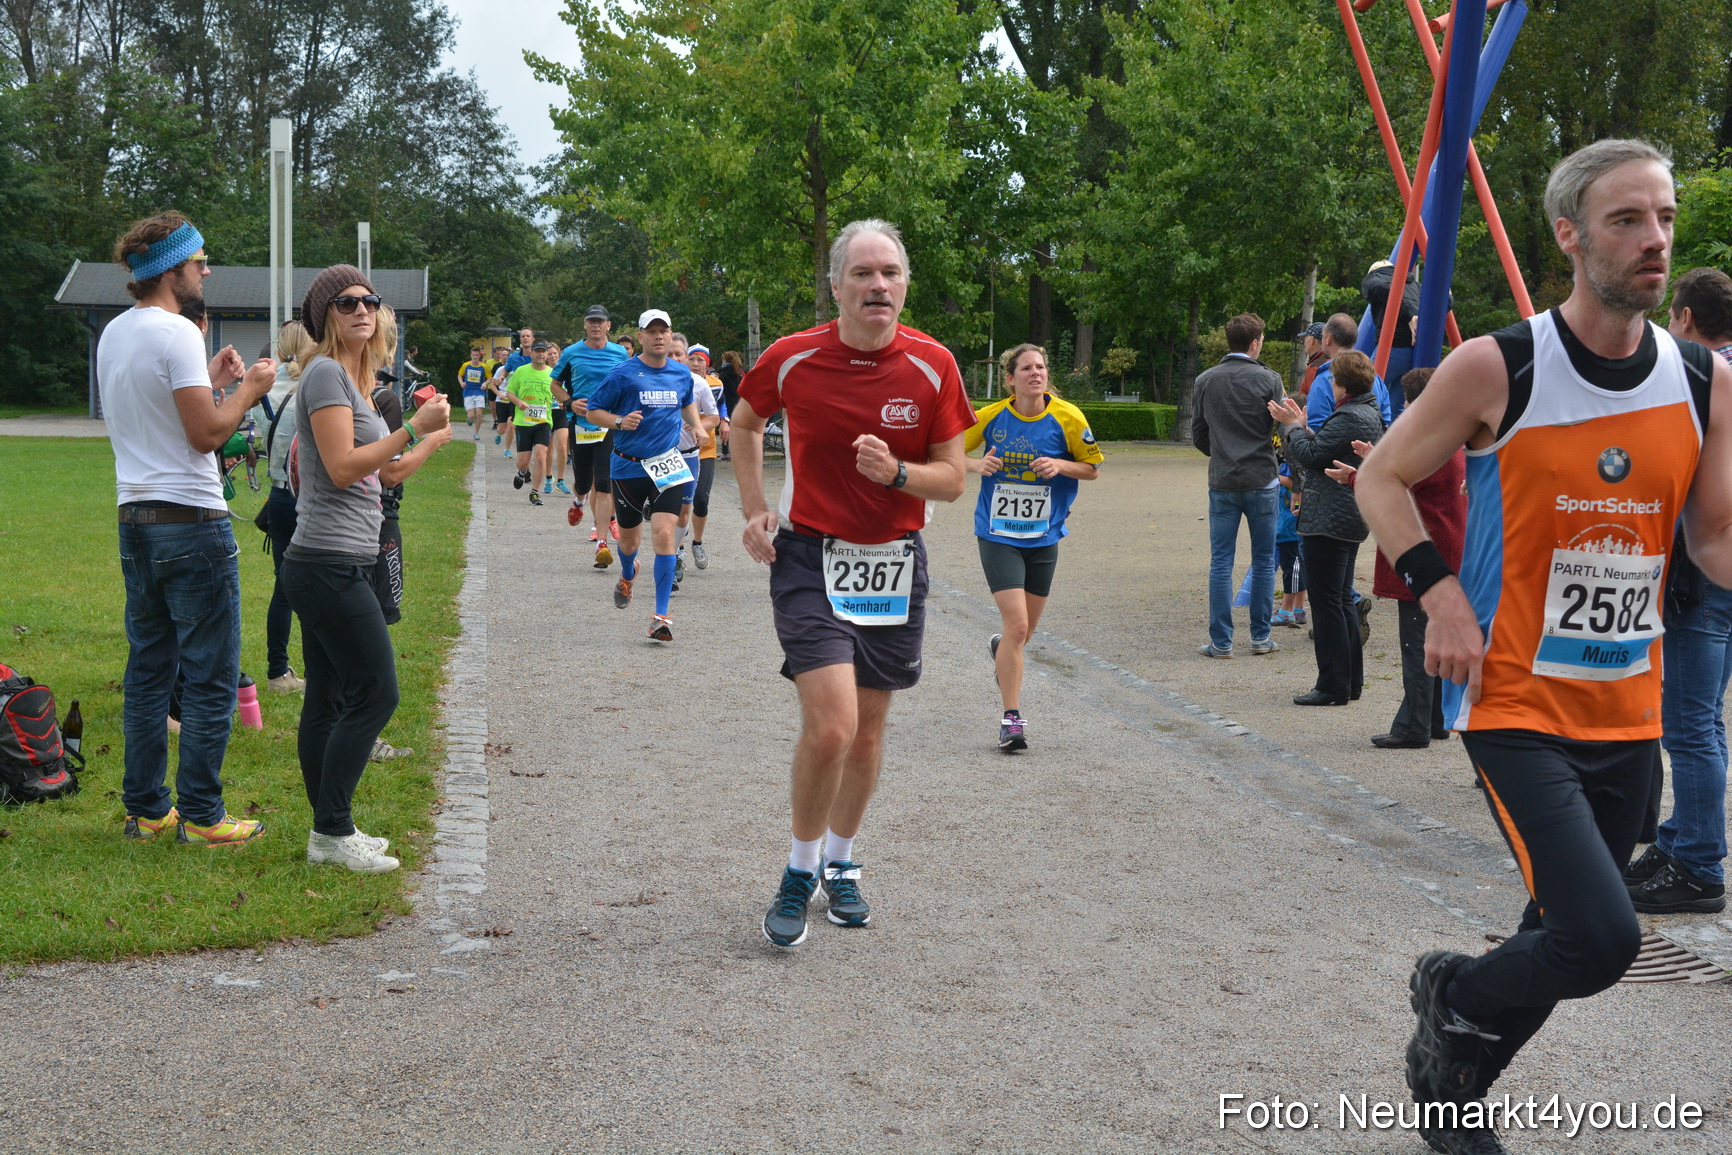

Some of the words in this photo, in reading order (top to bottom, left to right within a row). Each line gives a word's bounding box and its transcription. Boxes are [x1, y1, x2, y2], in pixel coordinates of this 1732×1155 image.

[639, 390, 678, 400] HUBER
[528, 409, 543, 418] 297
[650, 455, 684, 478] 2935
[1013, 489, 1042, 497] Neumarkt
[997, 497, 1046, 519] 2137
[1555, 494, 1664, 514] SportScheck
[1004, 521, 1035, 531] Melanie
[825, 547, 857, 557] PARTL
[859, 549, 901, 557] Neumarkt
[833, 560, 905, 592] 2367
[1554, 562, 1600, 578] PARTL
[1603, 567, 1652, 580] Neumarkt
[843, 600, 891, 613] Bernhard
[1558, 583, 1653, 634] 2582
[1581, 645, 1629, 664] Muris
